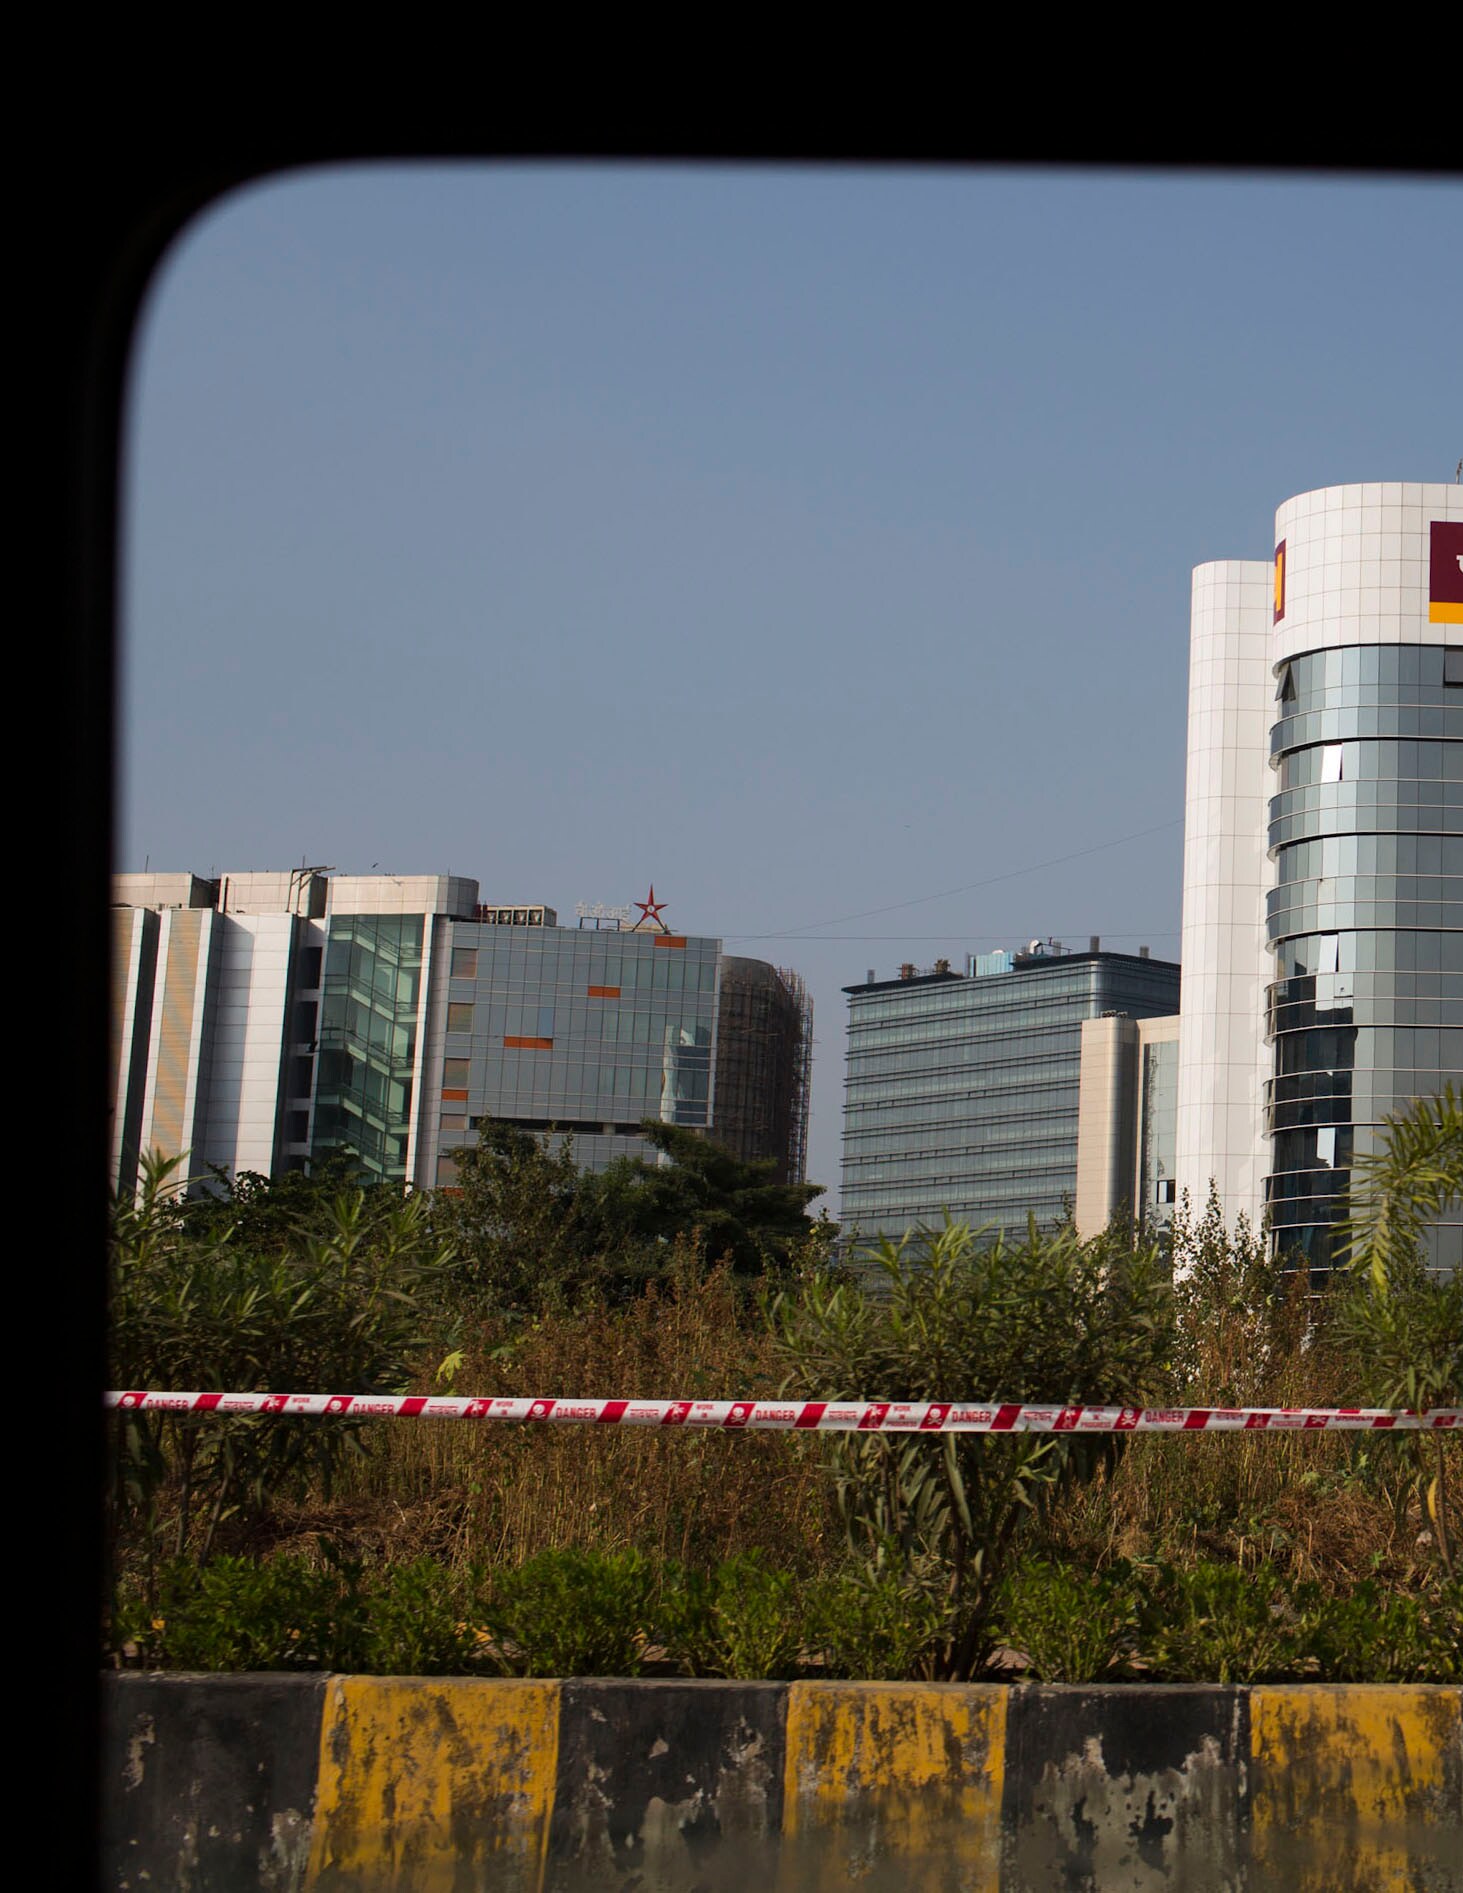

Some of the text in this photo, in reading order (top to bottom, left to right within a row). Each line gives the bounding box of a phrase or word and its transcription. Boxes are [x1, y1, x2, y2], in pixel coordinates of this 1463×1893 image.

[353, 1403, 395, 1415] DANGER
[555, 1407, 597, 1419] DANGER
[755, 1410, 796, 1422] DANGER
[951, 1411, 992, 1423] DANGER
[1145, 1410, 1185, 1423] DANGER
